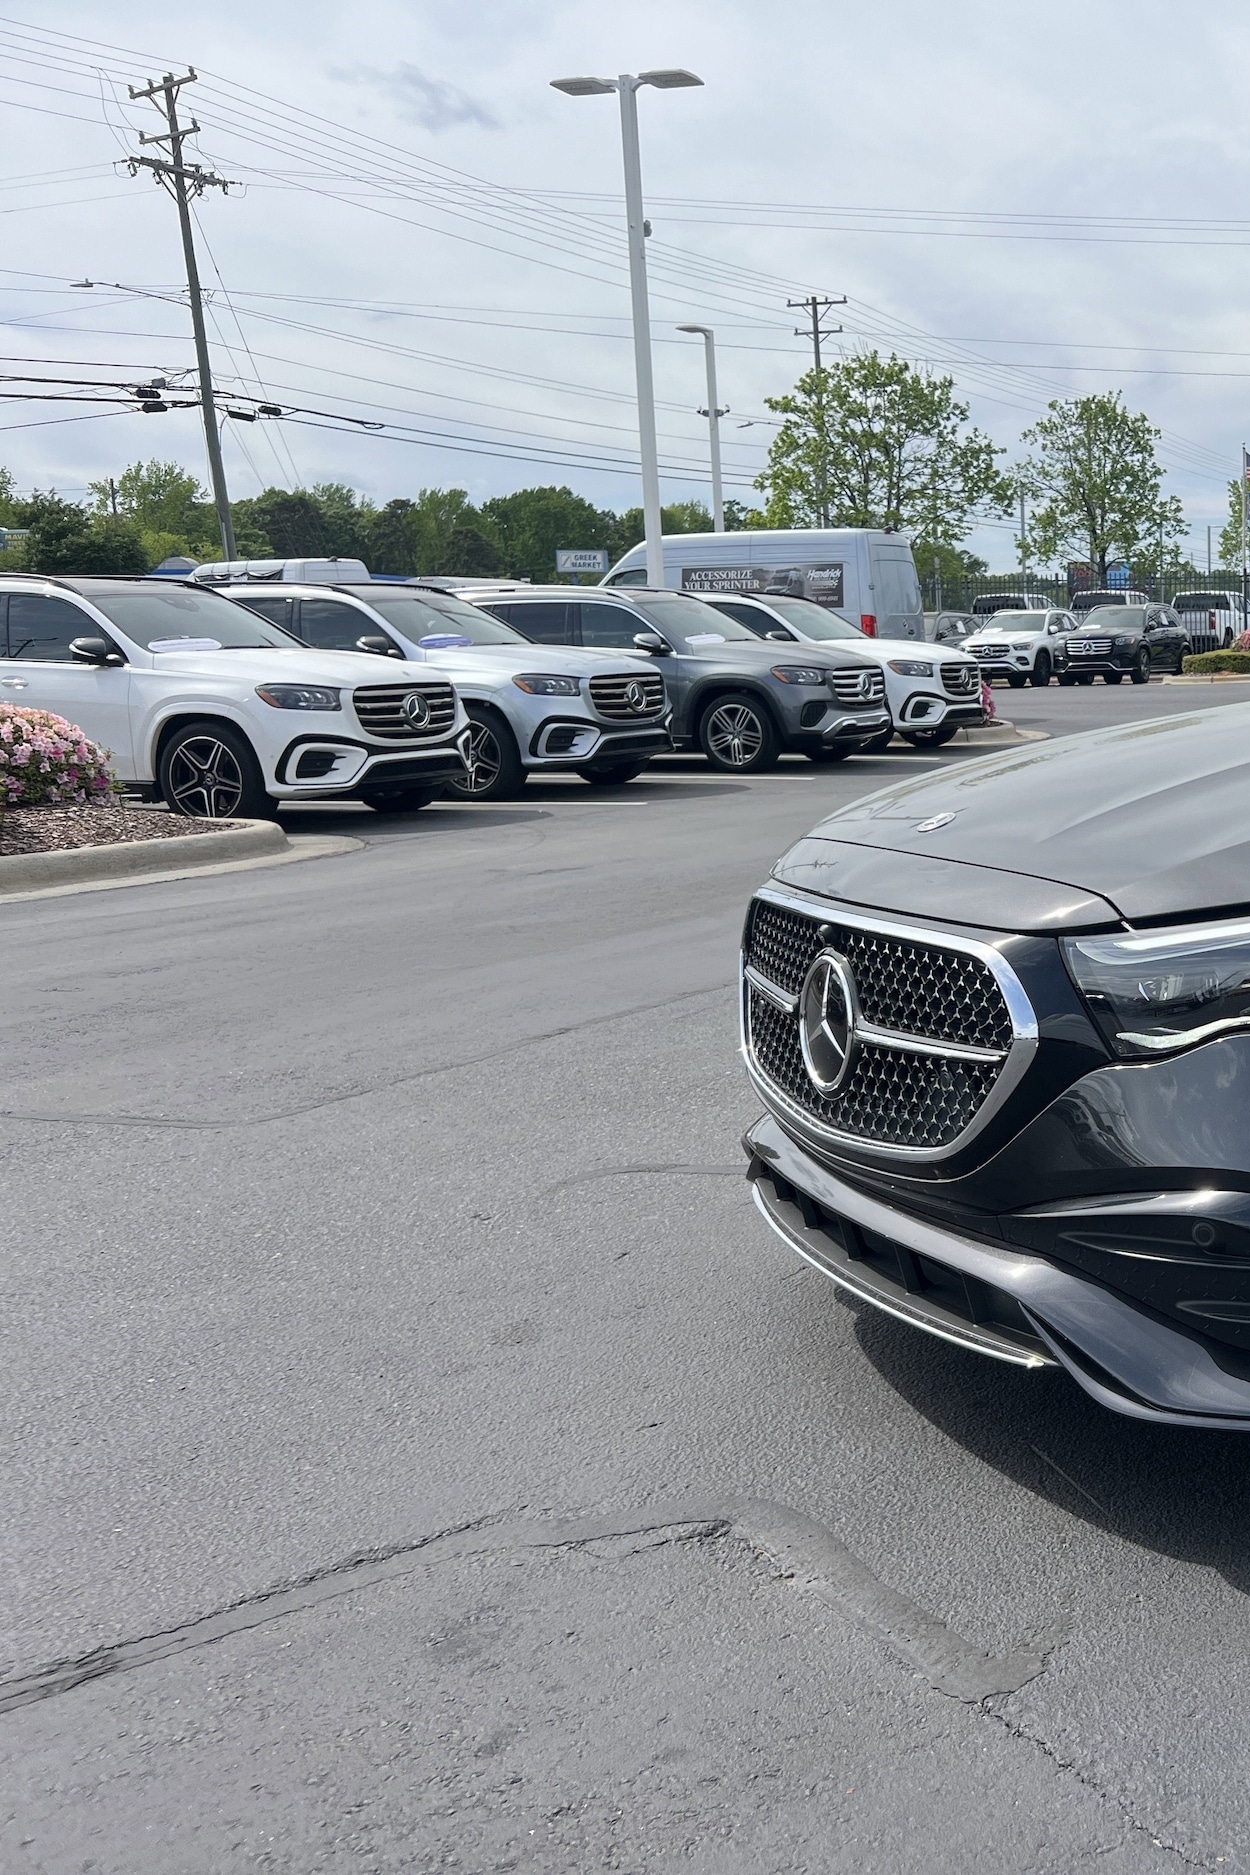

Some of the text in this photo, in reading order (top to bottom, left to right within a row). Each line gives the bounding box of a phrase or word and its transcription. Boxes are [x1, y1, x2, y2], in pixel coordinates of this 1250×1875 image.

[571, 561, 602, 569] MARKET
[689, 569, 754, 581] ACCESSORIZE
[806, 568, 842, 581] Hendrick
[684, 579, 760, 591] YOUR SPRINTER
